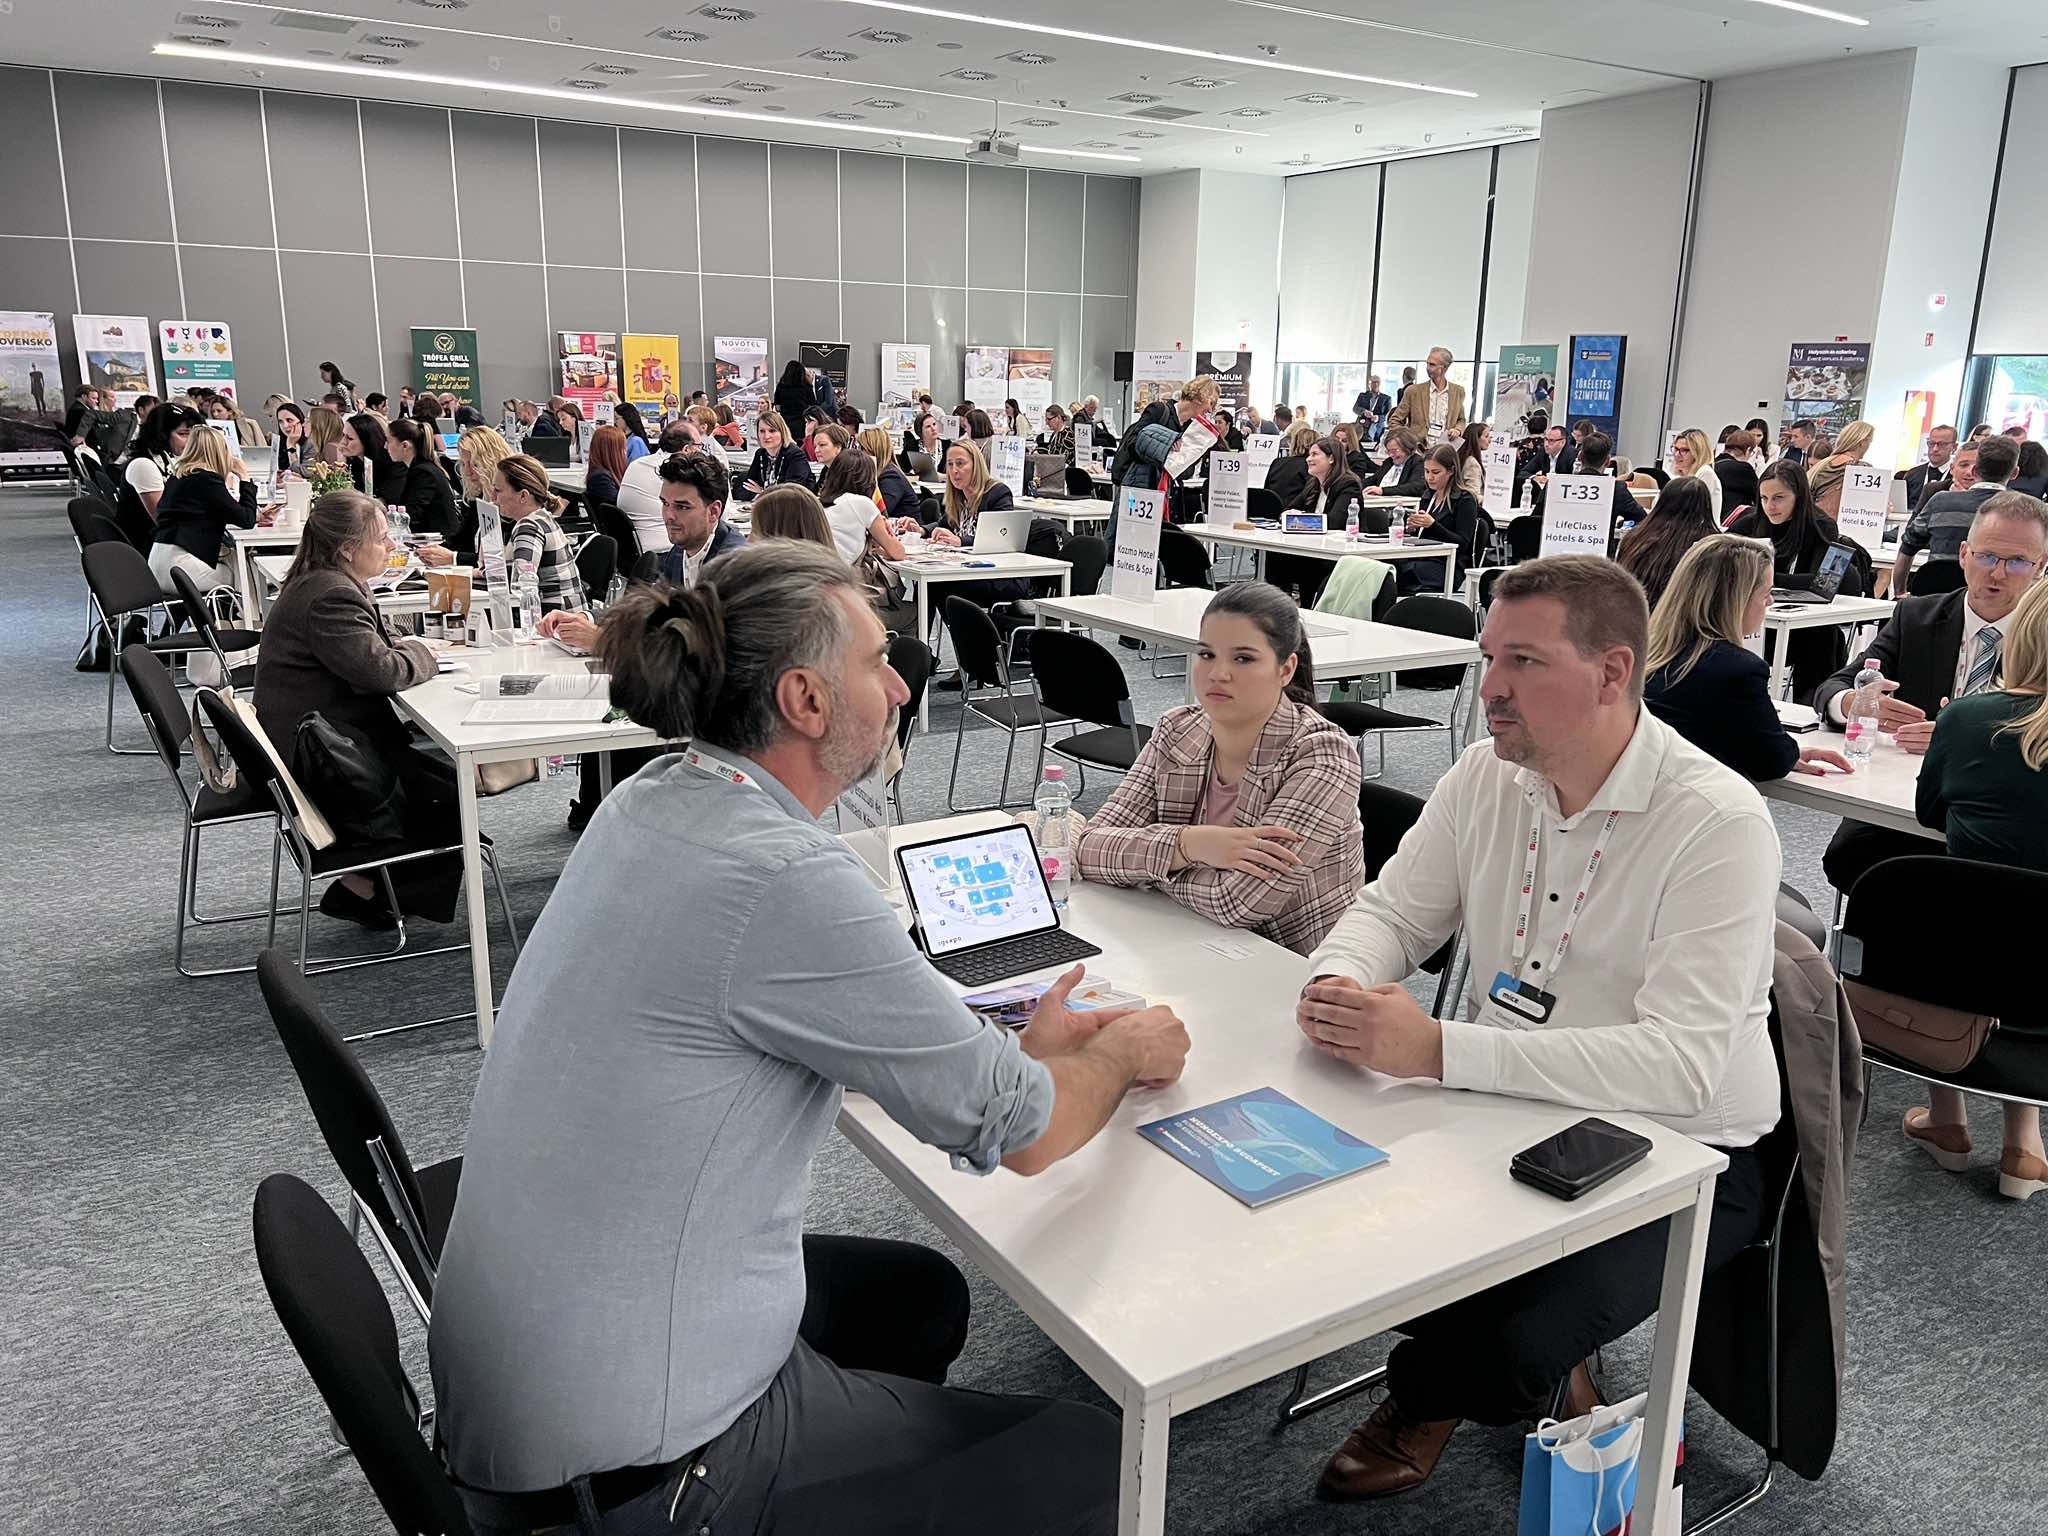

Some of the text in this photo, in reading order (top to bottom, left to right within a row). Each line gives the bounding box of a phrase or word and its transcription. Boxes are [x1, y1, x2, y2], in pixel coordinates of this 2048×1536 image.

[1254, 440, 1273, 449] T-47
[1494, 453, 1510, 464] T-40
[1217, 459, 1240, 472] T-39
[1854, 474, 1881, 488] T-34
[1561, 484, 1600, 500] T-33
[1860, 509, 1884, 517] Therme
[1555, 520, 1598, 531] LifeClass
[1842, 517, 1859, 525] Hotel
[1866, 519, 1878, 528] Spa
[1546, 533, 1605, 546] Hotels & Spa
[1138, 548, 1156, 560] Hotel
[1117, 560, 1135, 571] Suites
[1142, 565, 1153, 576] Spa
